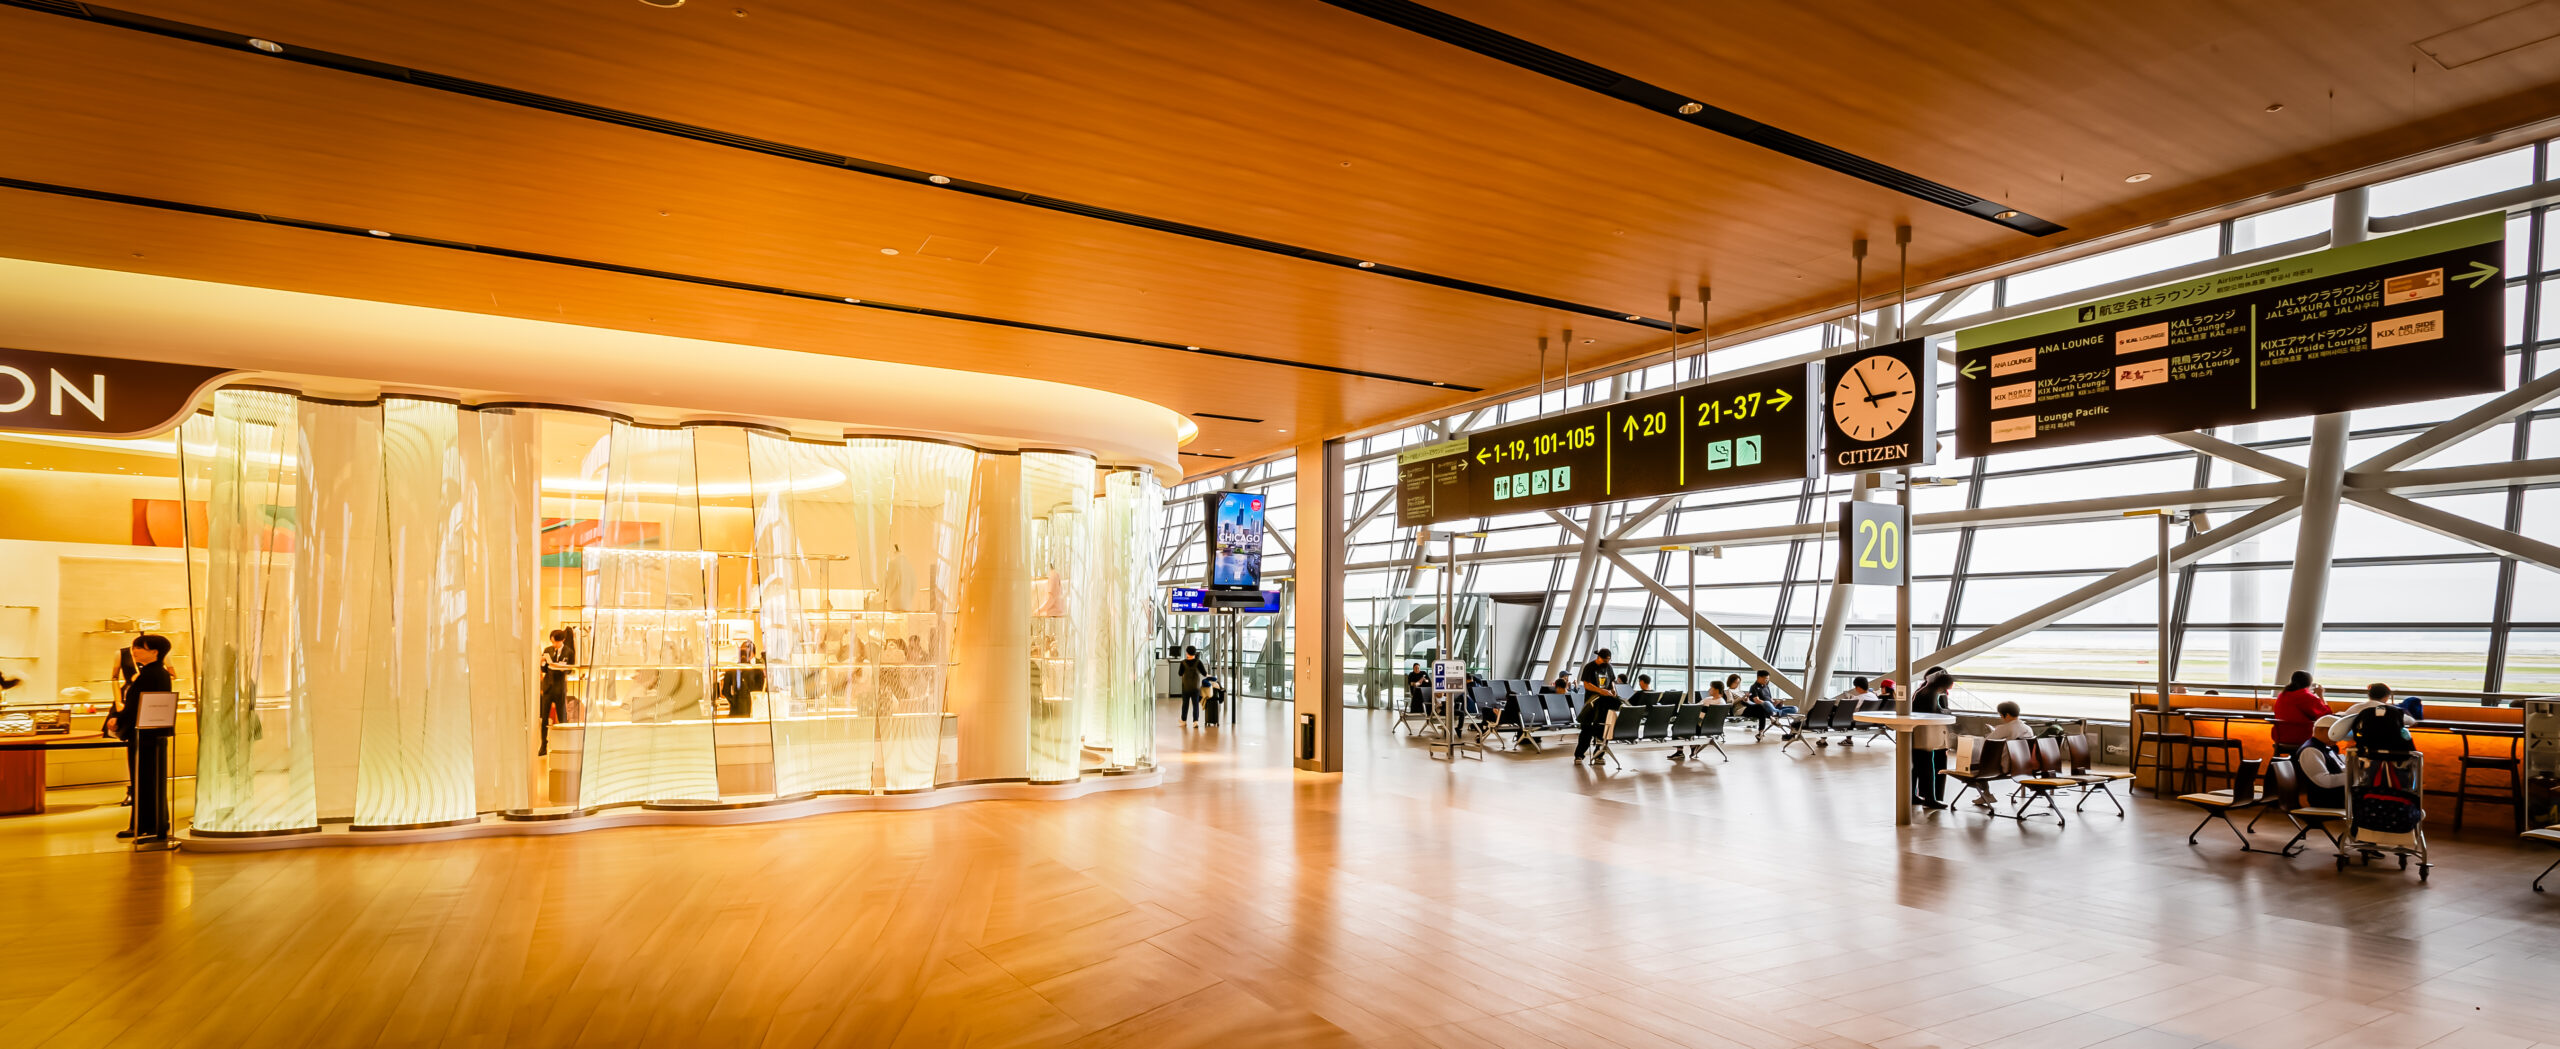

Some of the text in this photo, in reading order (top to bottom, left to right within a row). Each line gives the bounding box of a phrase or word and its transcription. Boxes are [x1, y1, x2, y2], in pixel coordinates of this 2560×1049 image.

[2217, 267, 2280, 285] Airline Lounges
[2099, 282, 2212, 316] 航空会社ラウンジ
[2275, 280, 2381, 308] JALサクララウンジ
[2265, 291, 2380, 320] JAL SAKURA LOUNGE
[2171, 309, 2236, 329] KALラウンジ
[2398, 319, 2436, 331] AIR SIDE
[2139, 332, 2165, 342] LOUNGE
[2171, 322, 2226, 338] KAL Lounge
[2260, 323, 2368, 350] KIXエアサイドラウンジ
[2376, 328, 2395, 338] KIX
[2398, 326, 2436, 337] LOUNGE
[2038, 334, 2105, 355] ANA LOUNGE
[2268, 336, 2367, 358] KIX Airside Lounge
[1993, 356, 2033, 369] ANA LOUNGE
[2171, 363, 2205, 374] ASUKA
[2205, 357, 2240, 368] Lounge
[2038, 368, 2111, 388] KIXノースラウンジ
[2038, 386, 2051, 395] KIX
[2053, 382, 2075, 393] North
[2076, 379, 2106, 390] Lounge
[2008, 388, 2032, 396] NORTH
[1698, 392, 1762, 426] 21-37
[2038, 406, 2110, 423] Lounge Pacific
[1643, 411, 1667, 437] 20
[1494, 440, 1529, 463] 1-19,
[1533, 425, 1595, 456] 101-105
[1838, 443, 1909, 466] CITIZEN
[1218, 532, 1261, 543] CHICAGO
[1858, 518, 1899, 570] 20
[1437, 665, 1444, 675] P
